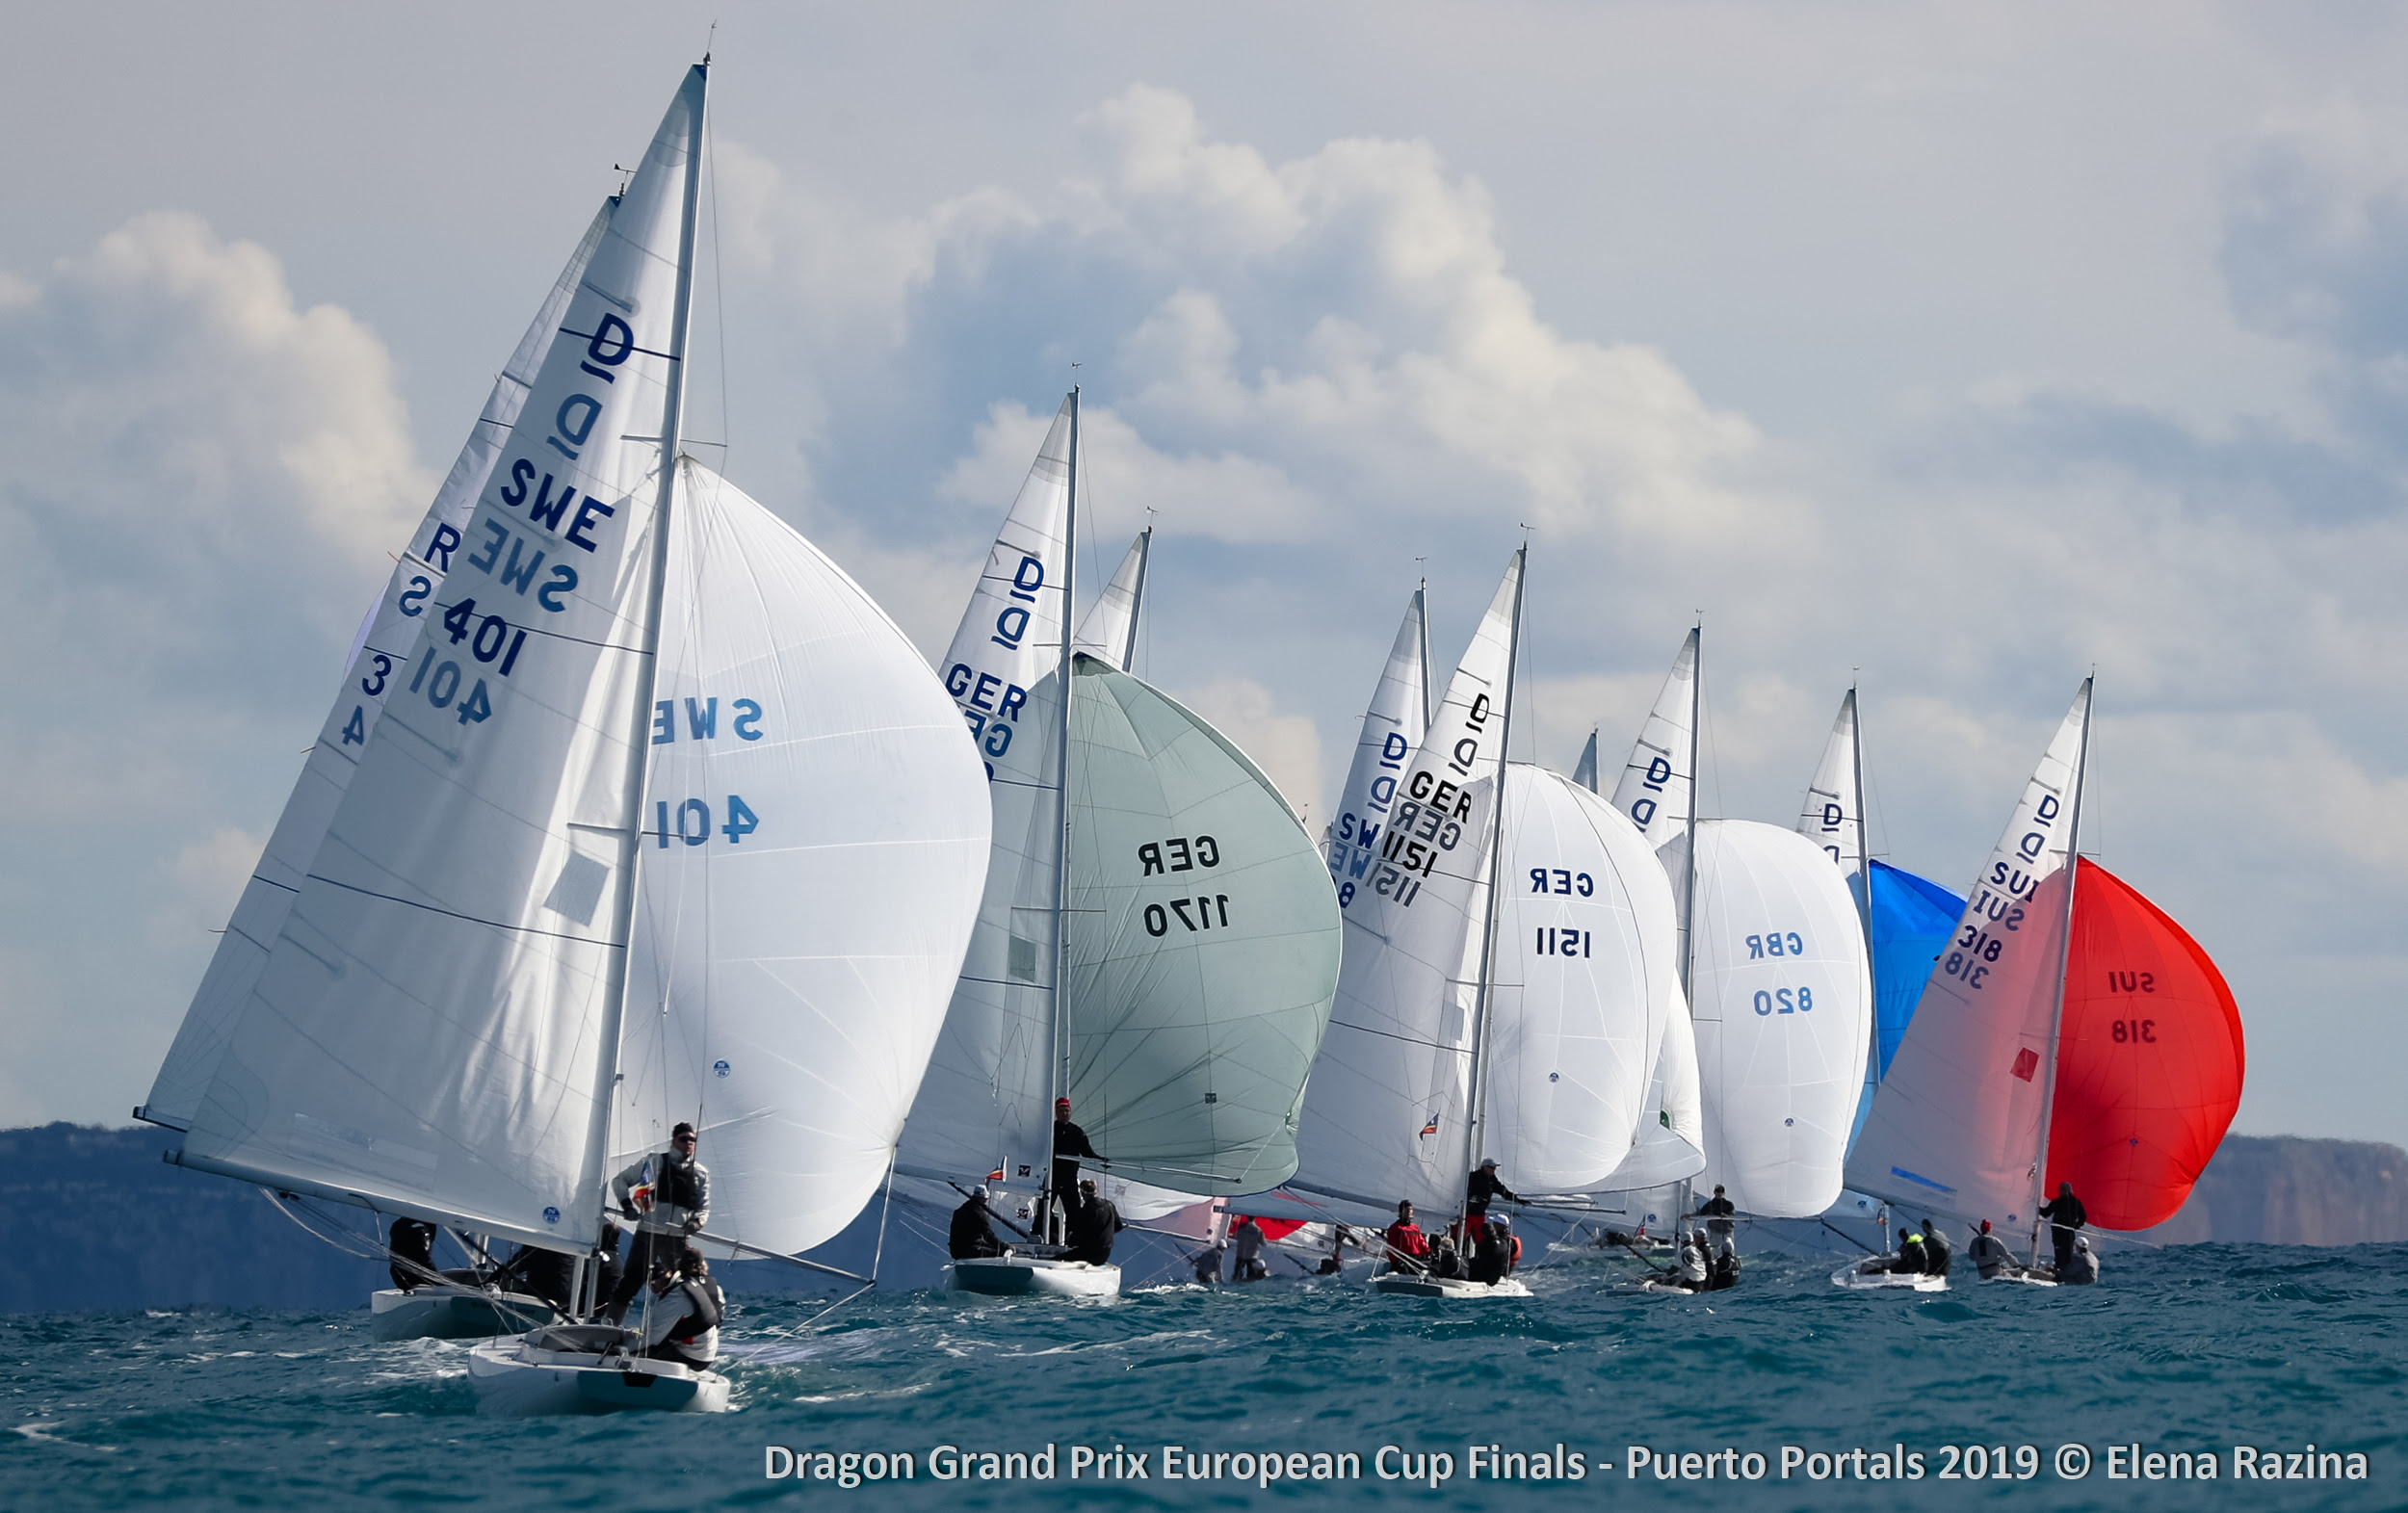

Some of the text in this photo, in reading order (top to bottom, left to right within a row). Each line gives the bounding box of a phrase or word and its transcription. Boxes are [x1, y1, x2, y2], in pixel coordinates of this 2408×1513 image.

[580, 312, 634, 383] D
[500, 458, 615, 553] SWE
[1009, 556, 1044, 603] D
[444, 597, 527, 677] 401
[946, 663, 1027, 722] GER
[1465, 693, 1490, 734] D
[1379, 732, 1408, 770] D
[1410, 770, 1472, 824] GER
[1642, 757, 1671, 793] D
[1820, 803, 1843, 832] D
[2032, 795, 2059, 827] D
[1382, 830, 1438, 878] 1151
[1990, 862, 2040, 903] SUI
[1957, 925, 2002, 962] 318
